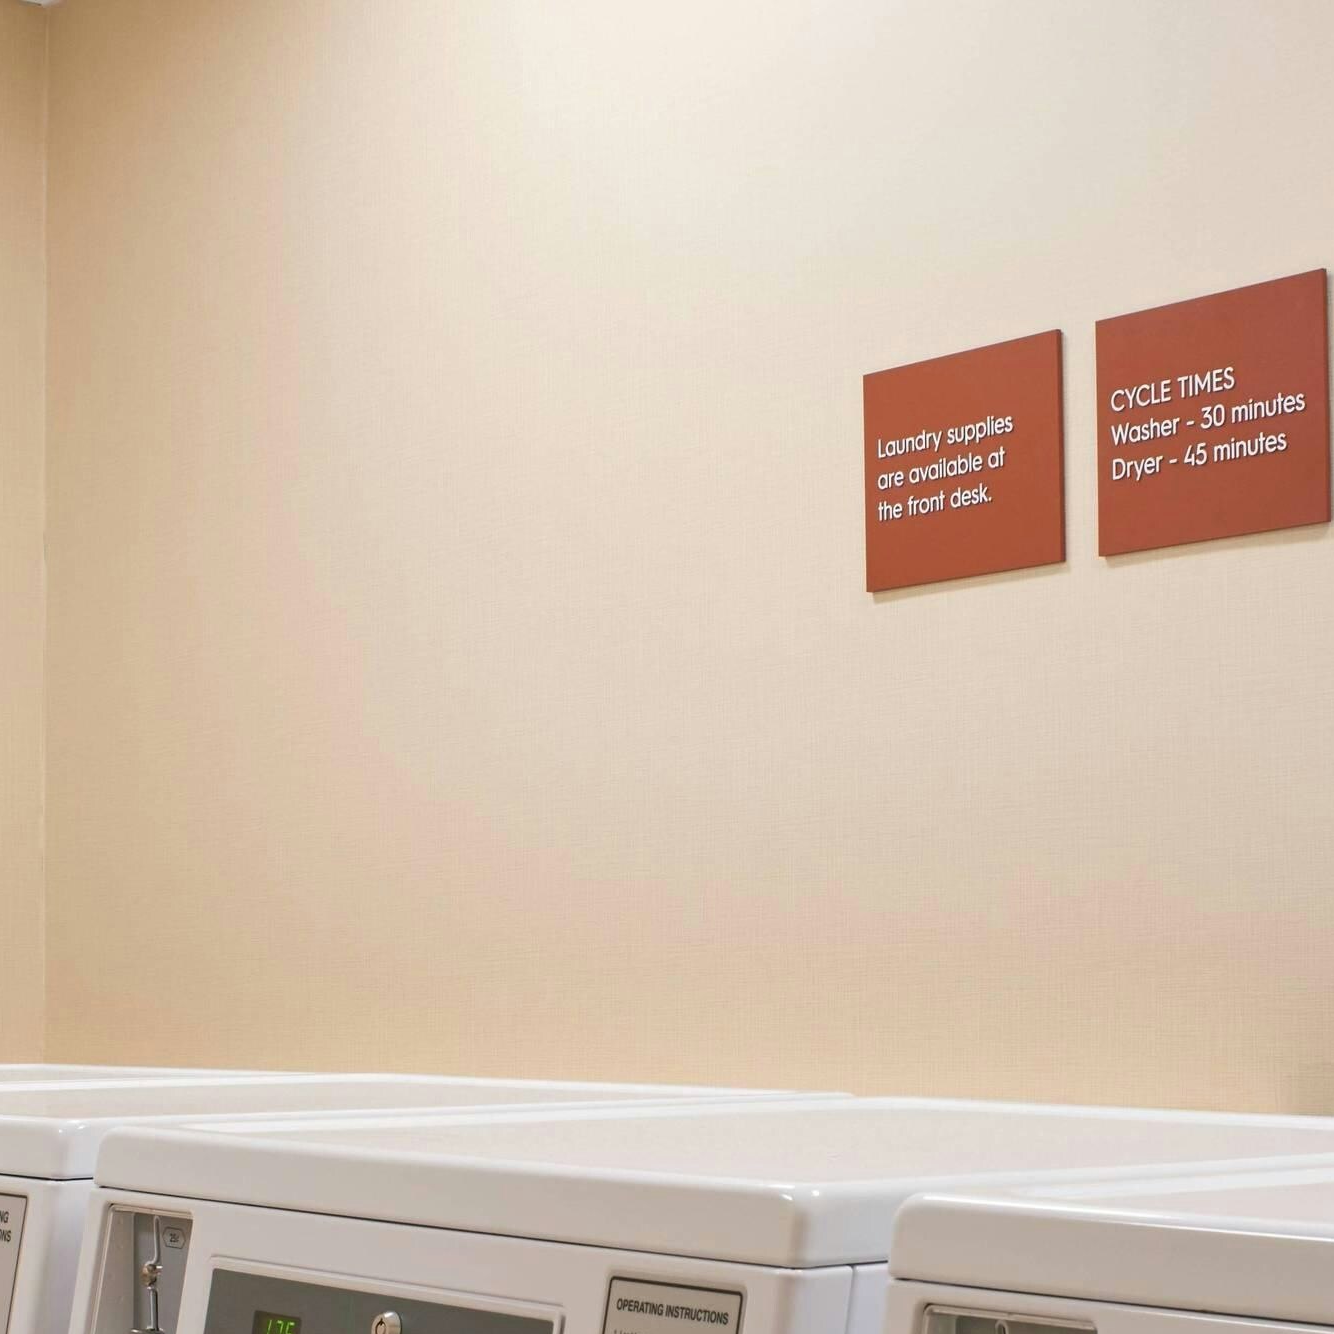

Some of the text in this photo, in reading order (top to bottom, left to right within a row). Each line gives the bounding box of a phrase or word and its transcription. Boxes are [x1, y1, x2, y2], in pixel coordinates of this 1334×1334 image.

[1111, 367, 1235, 412] CYCLE TIMES
[878, 416, 1013, 458] Laundry supplies
[1111, 417, 1180, 445] Washer
[1200, 404, 1225, 429] 30
[1231, 392, 1305, 423] minutes
[878, 446, 1005, 490] are available at
[1112, 455, 1163, 481] Dryer
[1184, 442, 1207, 466] 45
[1214, 432, 1287, 462] minutes
[878, 483, 992, 521] the front desk.
[616, 1298, 729, 1325] OPERATING INSTRUCTIONS
